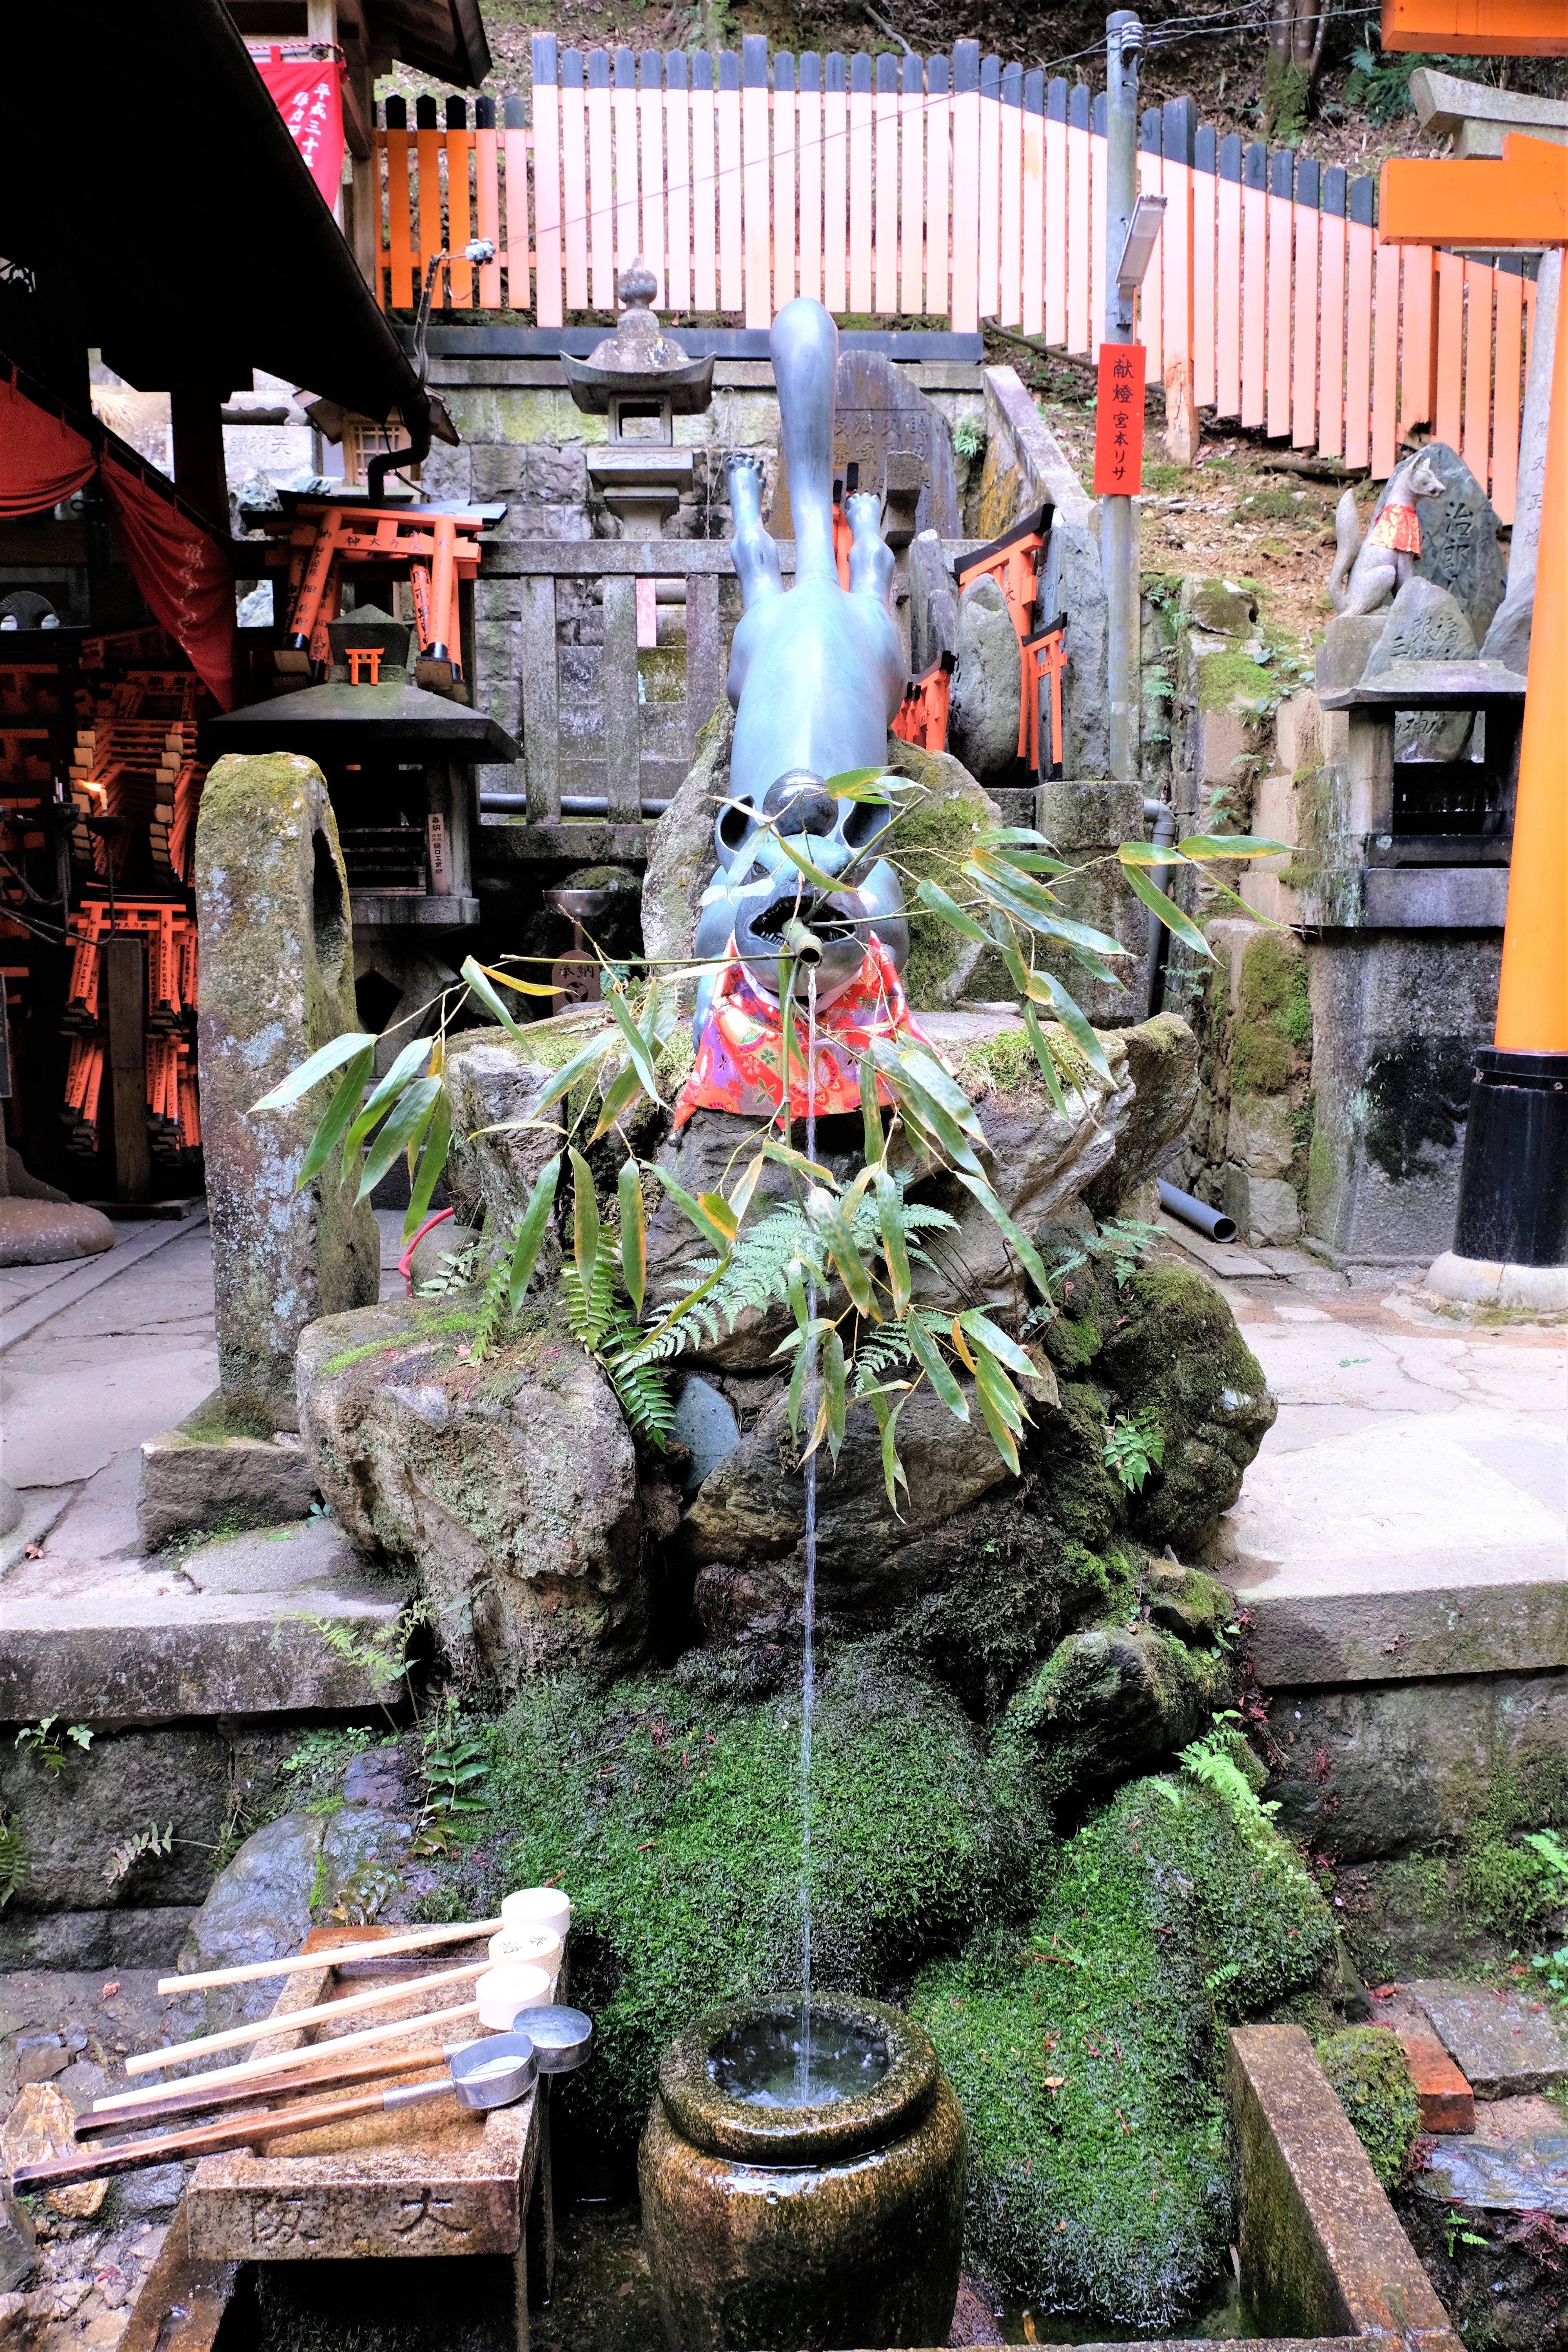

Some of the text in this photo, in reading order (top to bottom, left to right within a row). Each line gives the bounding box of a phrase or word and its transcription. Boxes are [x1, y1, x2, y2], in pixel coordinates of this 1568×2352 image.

[1112, 358, 1134, 481] 献燈 宮本リサ
[432, 817, 441, 831] 奉納
[558, 963, 594, 979] 奉納
